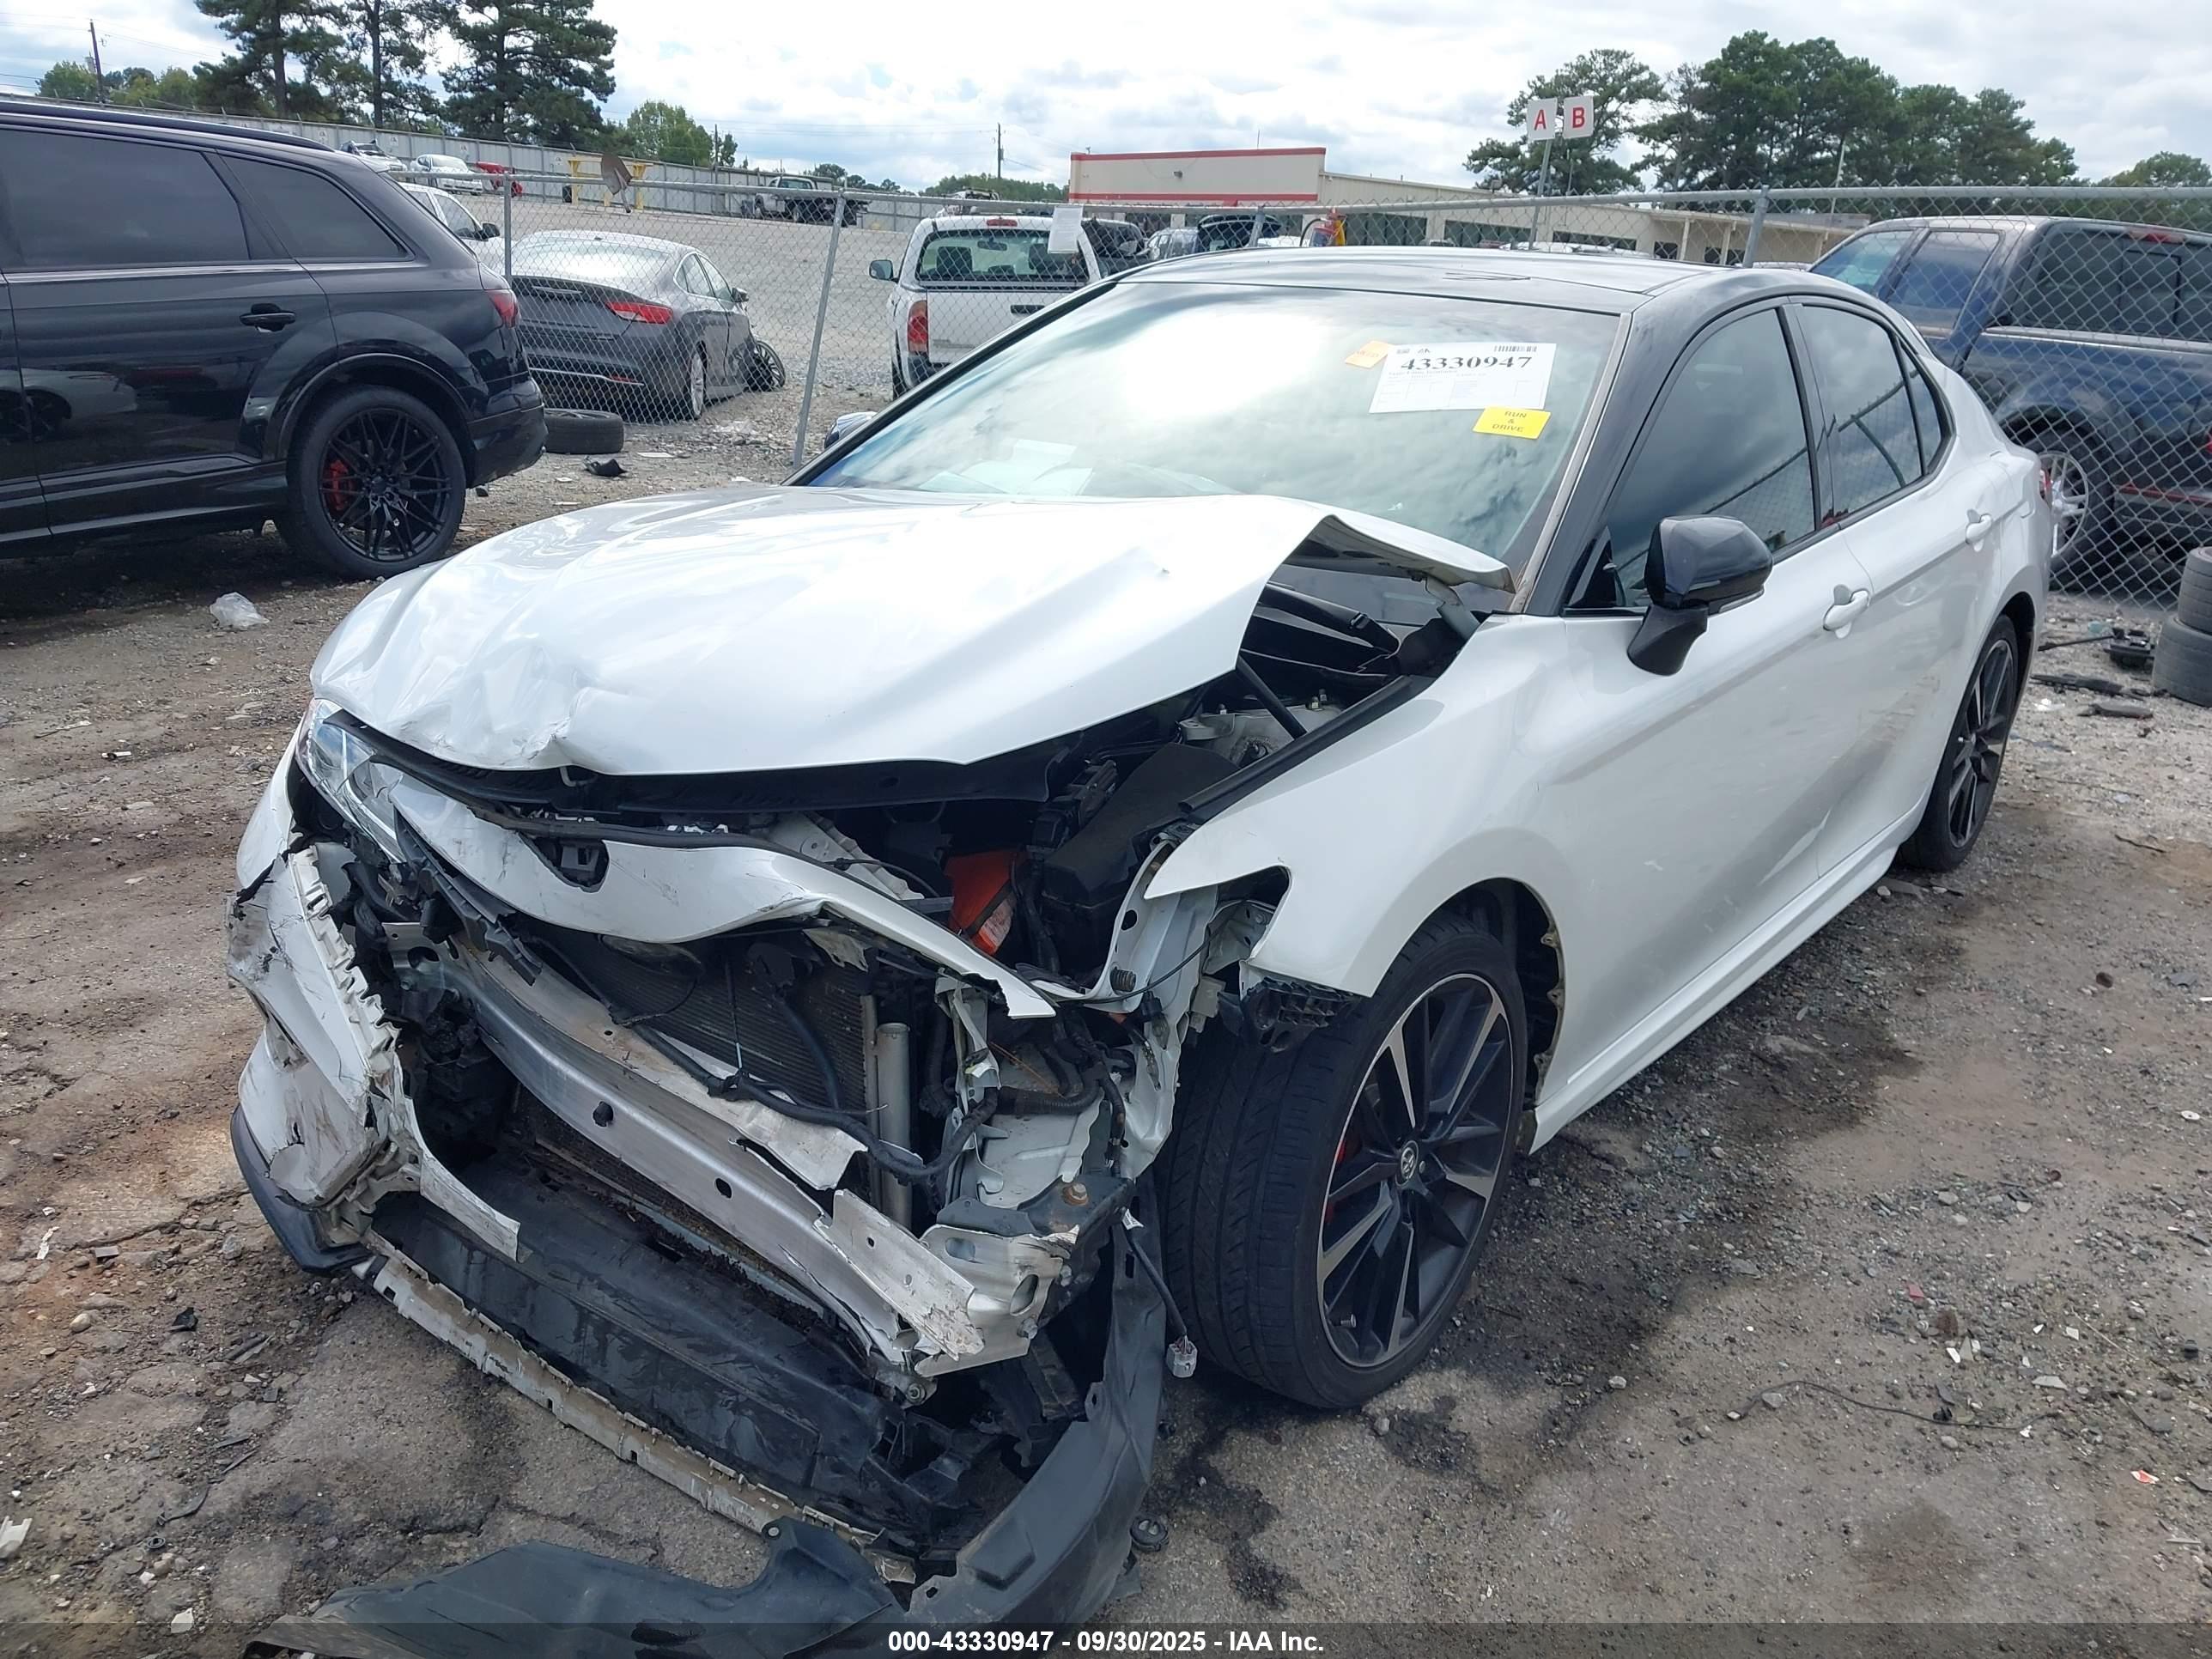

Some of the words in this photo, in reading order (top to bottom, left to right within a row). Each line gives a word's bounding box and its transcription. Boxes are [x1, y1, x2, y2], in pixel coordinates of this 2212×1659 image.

[1534, 109, 1547, 131] A
[1572, 106, 1585, 129] B
[1401, 356, 1533, 371] 43330947
[1504, 410, 1528, 419] RUN
[1492, 422, 1526, 433] DRIVE
